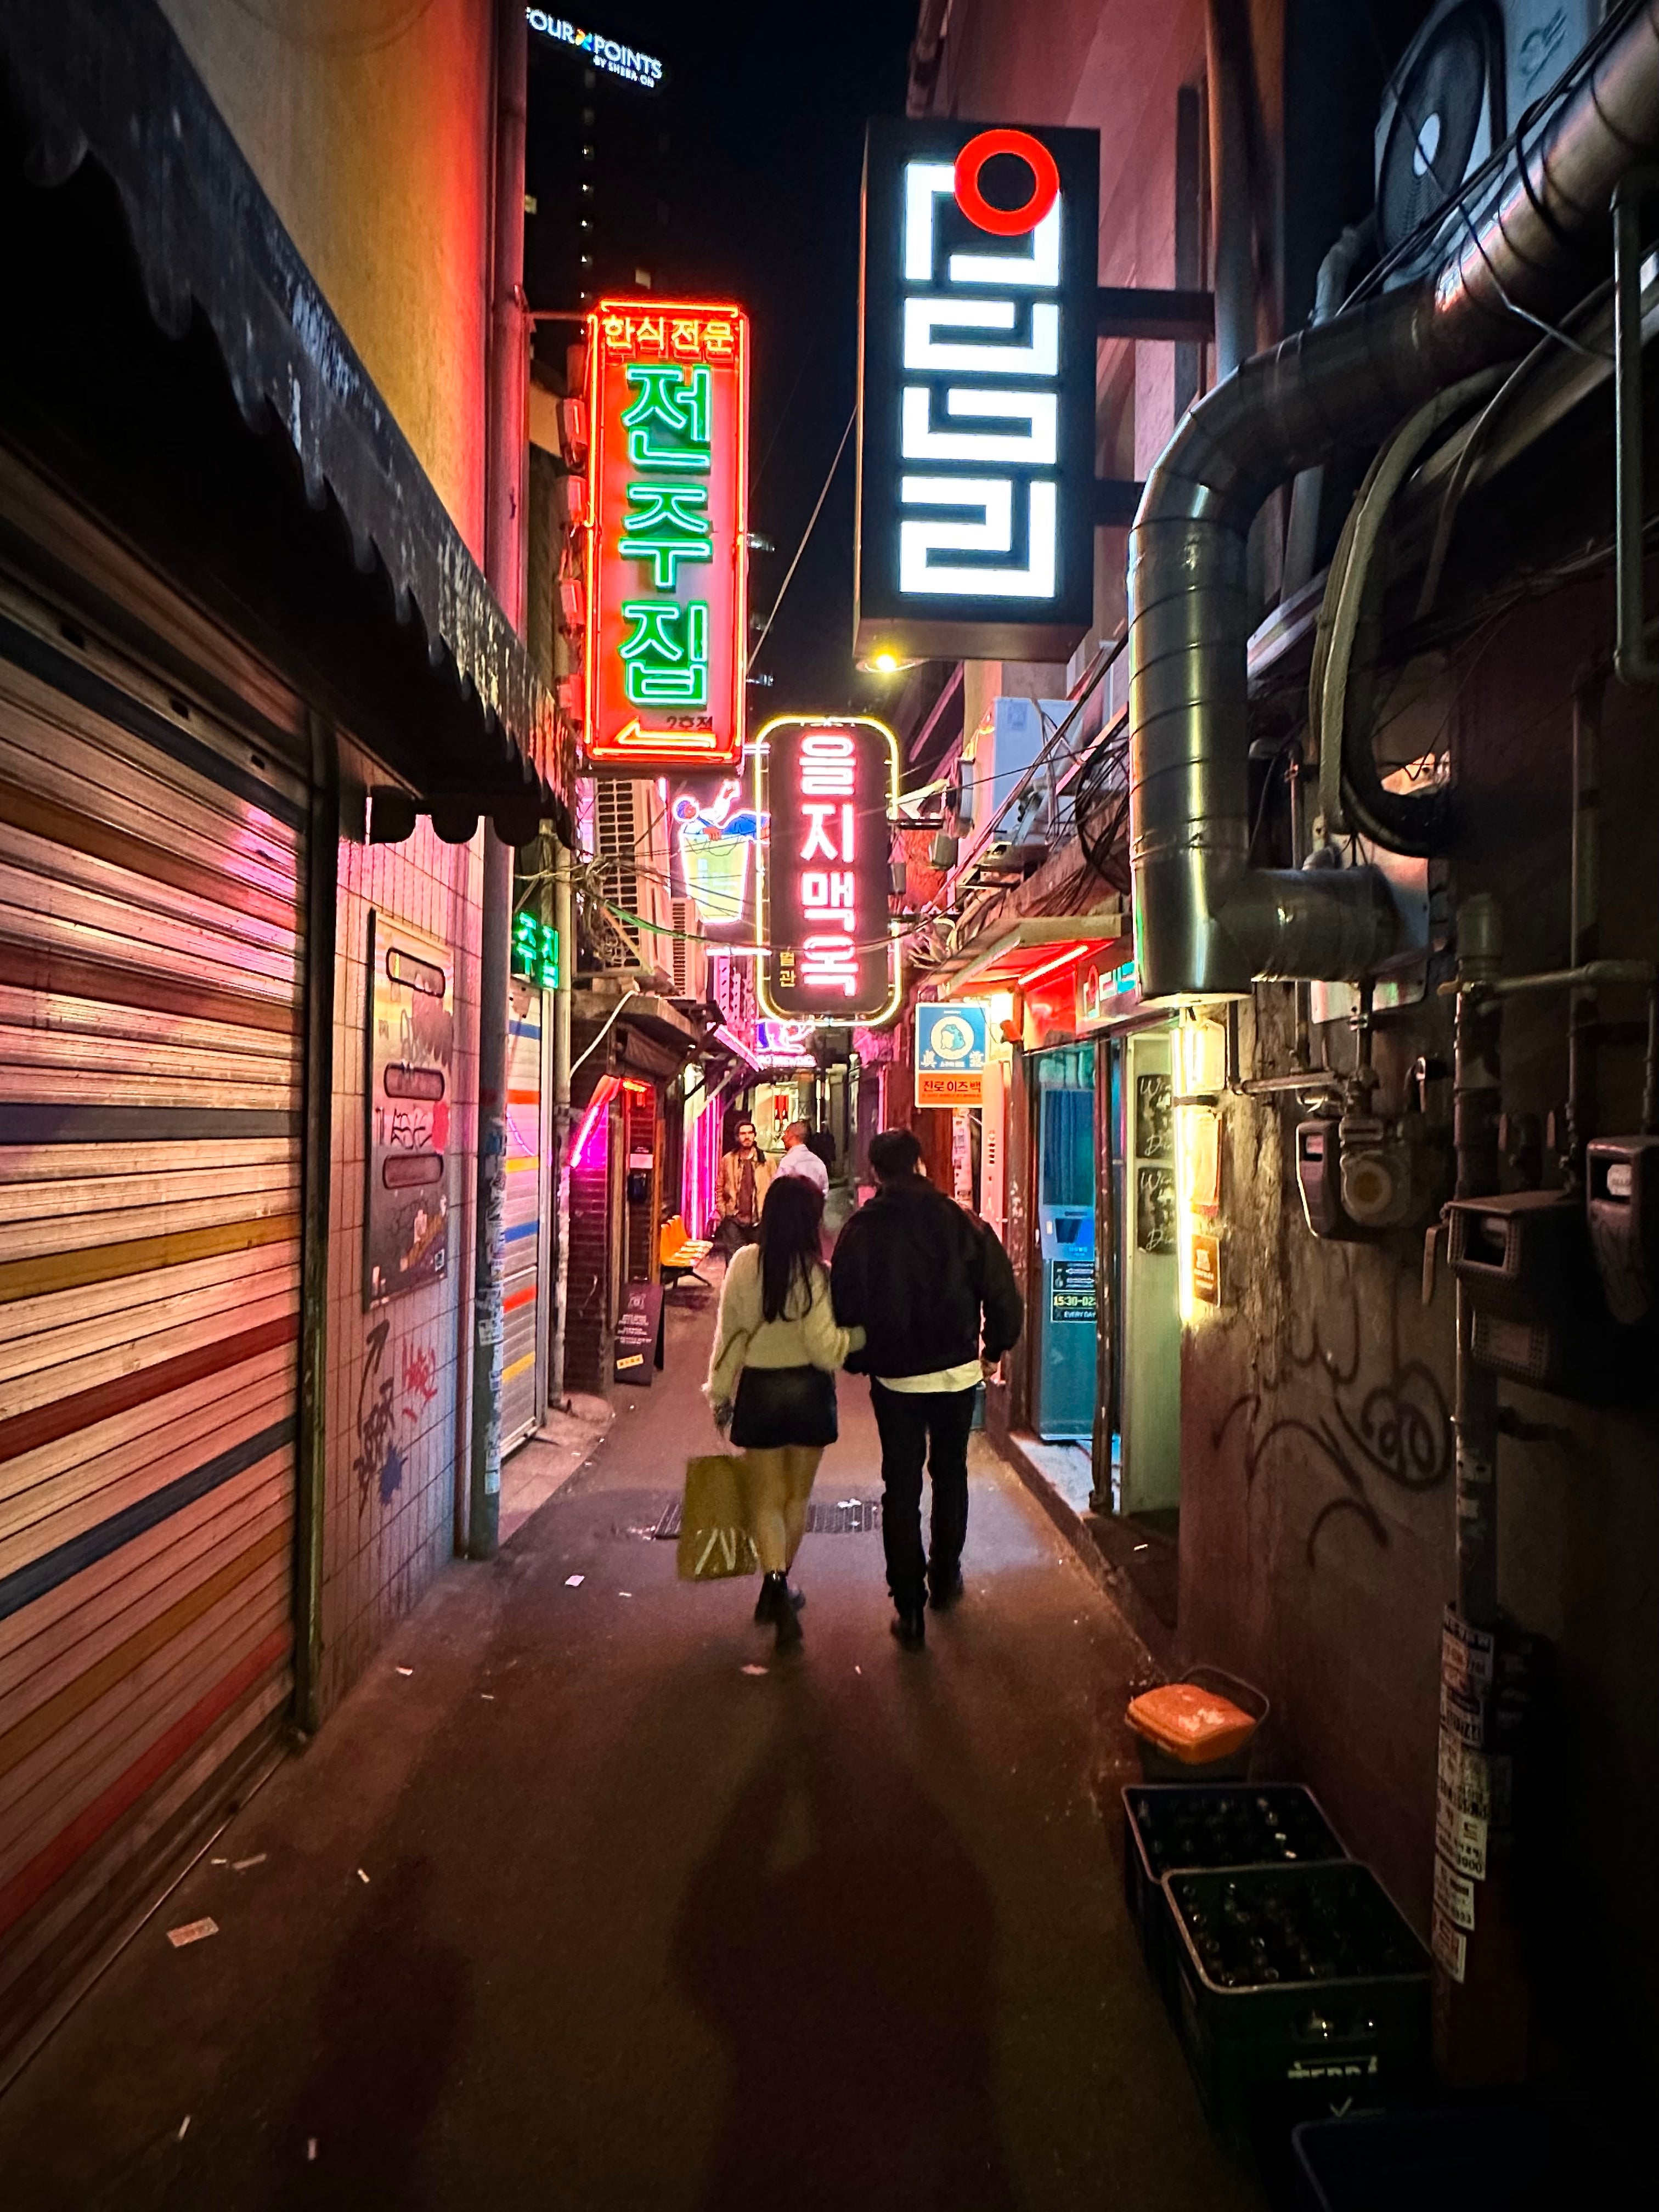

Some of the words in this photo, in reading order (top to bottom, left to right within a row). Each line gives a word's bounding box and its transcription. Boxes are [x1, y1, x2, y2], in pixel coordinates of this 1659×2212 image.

[594, 33, 662, 80] POINTS
[603, 317, 665, 349] 한식
[671, 317, 736, 353] 전문
[618, 364, 713, 707] 전주집
[799, 733, 860, 997] 을지맥옥
[923, 1080, 945, 1092] 진로
[947, 1081, 968, 1092] 이즈
[970, 1081, 981, 1093] 백
